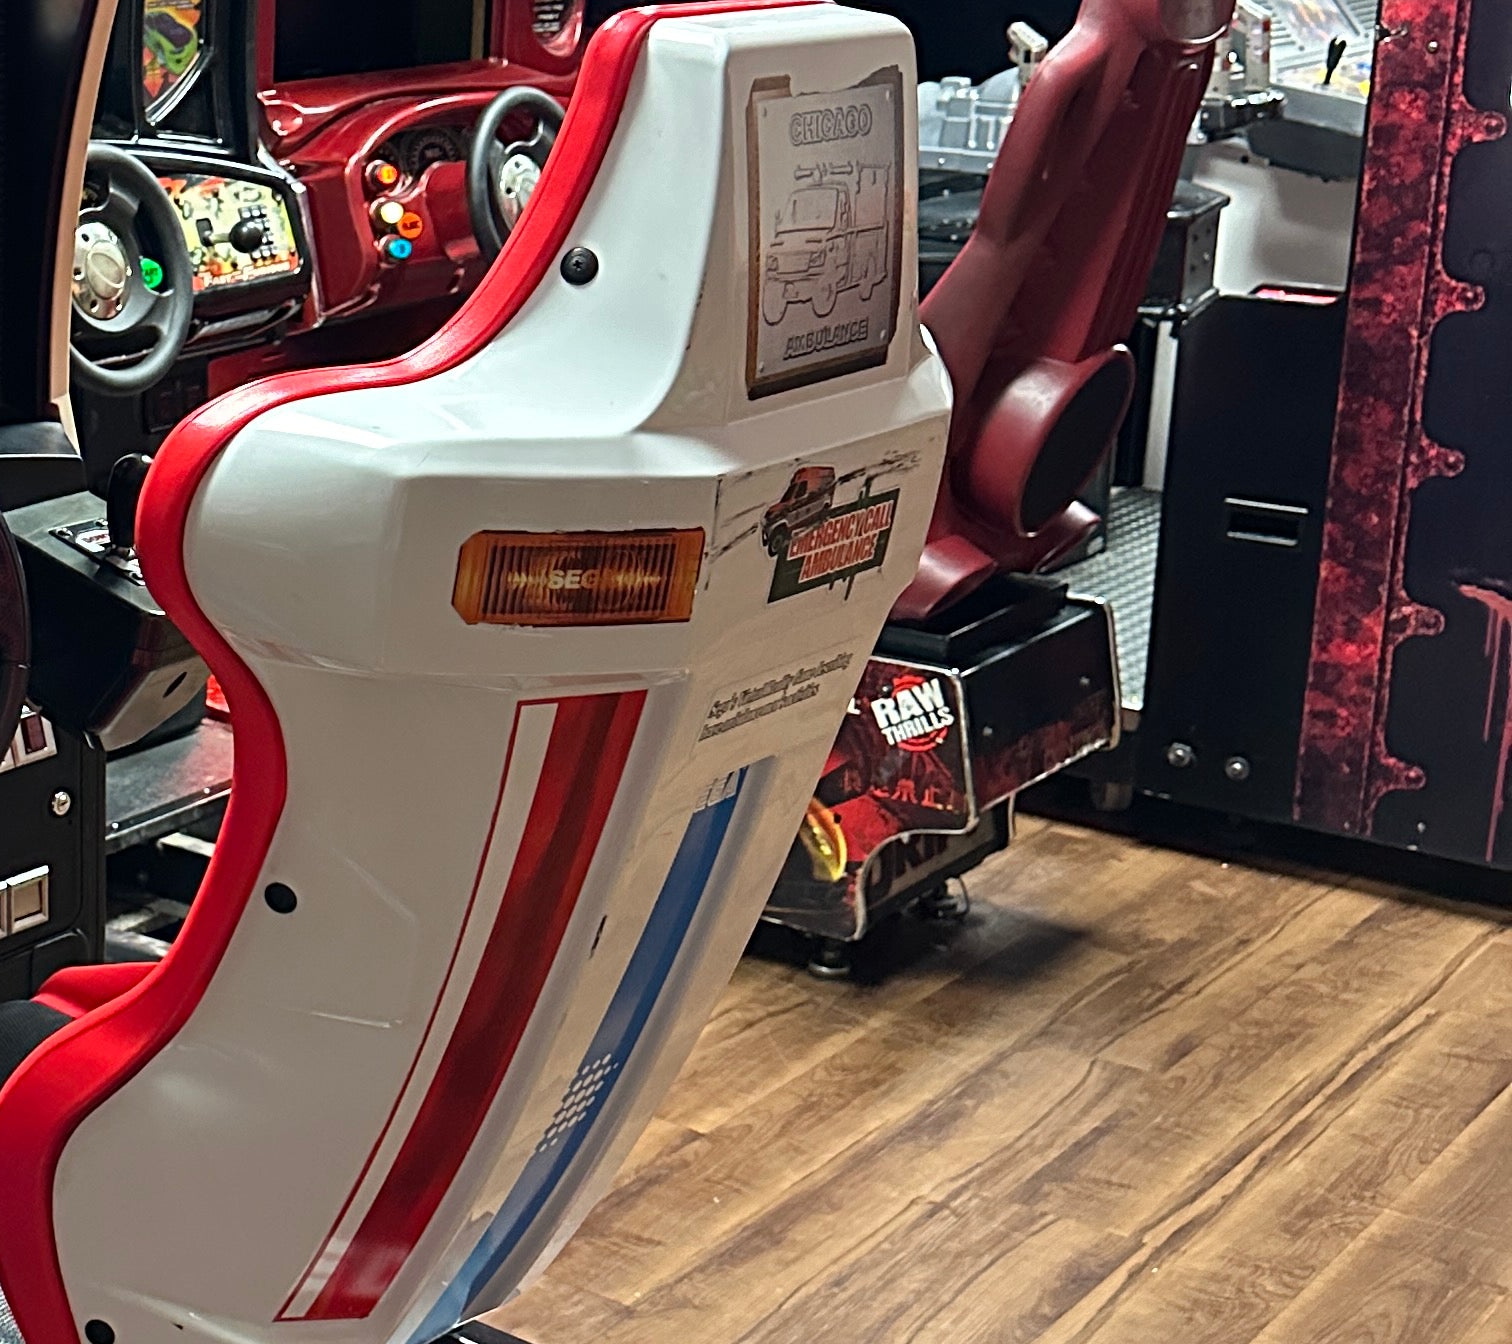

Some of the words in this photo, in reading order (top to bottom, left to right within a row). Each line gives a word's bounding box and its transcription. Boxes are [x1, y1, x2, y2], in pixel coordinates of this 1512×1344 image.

[790, 103, 873, 146] CHICAGO
[783, 317, 869, 360] AMBULANCE
[789, 512, 867, 558] EMERGENCY
[862, 502, 893, 536] CALL
[800, 532, 878, 581] AMBULANCE
[870, 677, 945, 729] RAW
[880, 706, 955, 746] THRILLS
